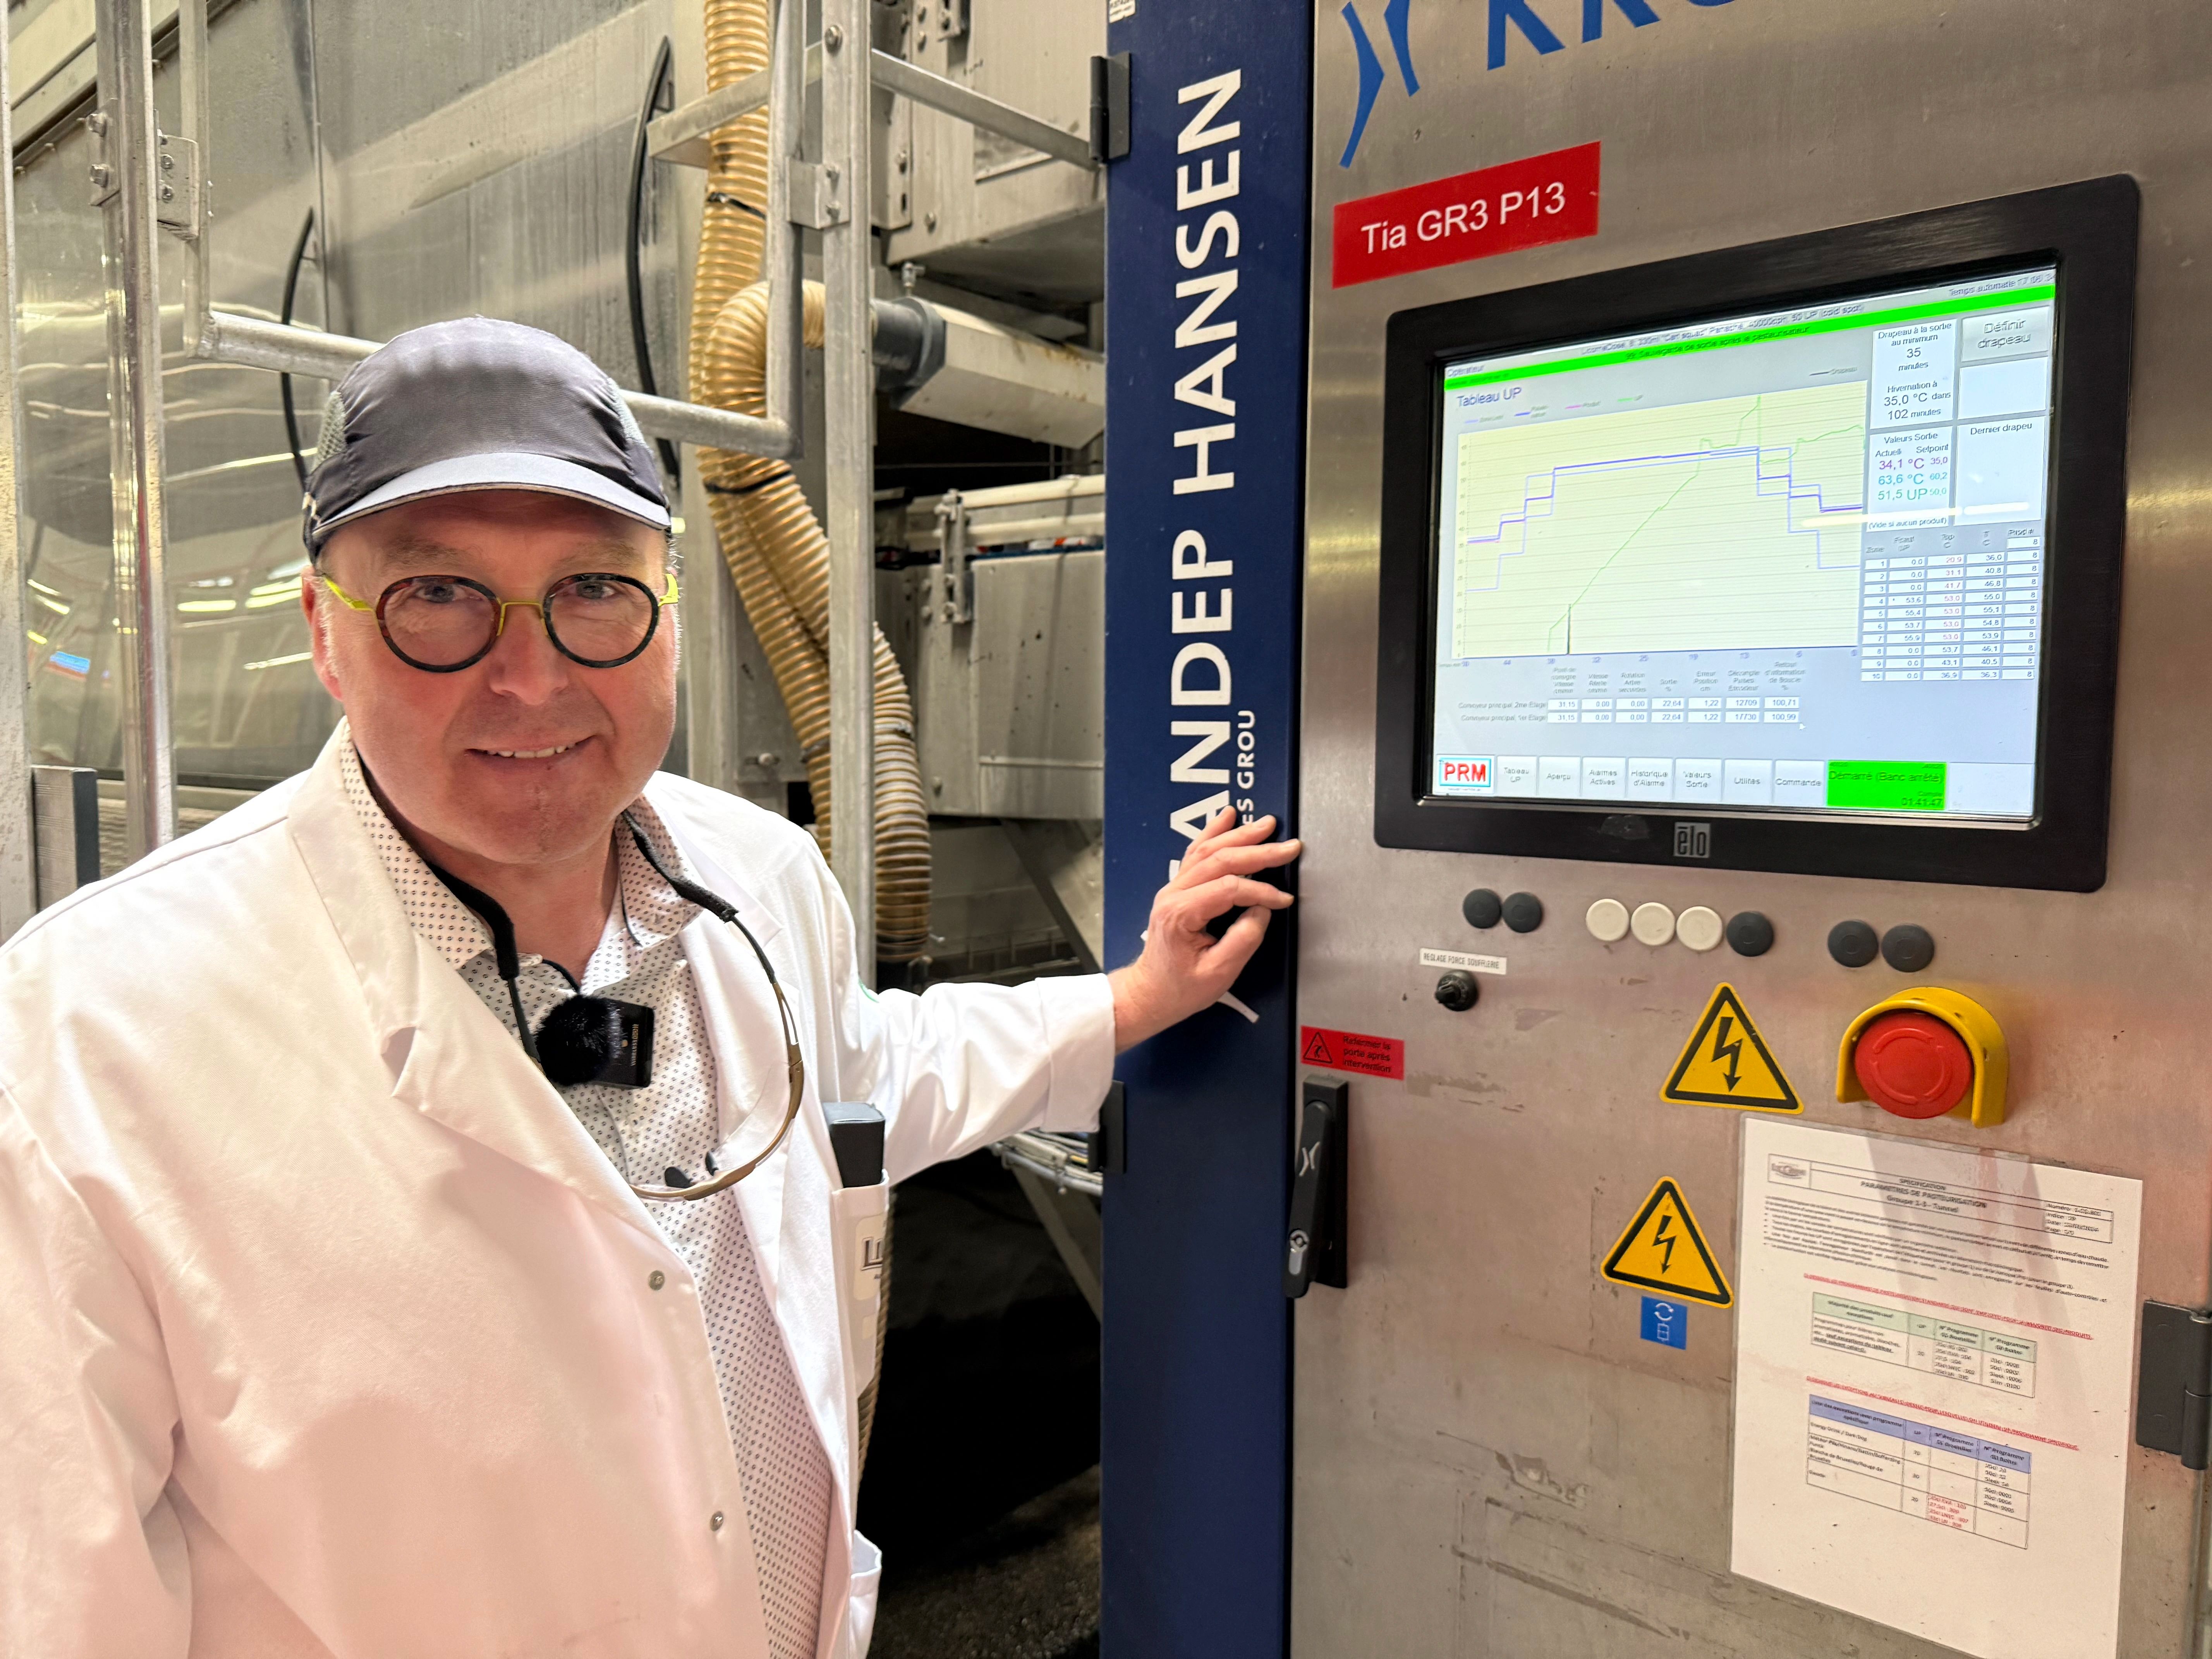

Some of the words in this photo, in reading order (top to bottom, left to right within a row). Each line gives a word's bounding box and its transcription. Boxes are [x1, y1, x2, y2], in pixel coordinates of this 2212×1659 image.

[1360, 221, 1407, 254] Tia
[1417, 199, 1489, 242] GR3
[1500, 182, 1566, 225] P13
[1173, 69, 1241, 495] HANSEN
[1984, 318, 2026, 333] Définir
[1878, 328, 1912, 340] Drapeau
[1914, 326, 1918, 335] à
[1903, 333, 1938, 345] minimum
[1978, 333, 2031, 349] drapeau
[1907, 348, 1921, 358] 35
[1898, 361, 1928, 372] minutes
[1887, 382, 1930, 393] Hivernation
[1457, 390, 1500, 407] Tableau
[1503, 387, 1522, 400] UP
[1884, 395, 1909, 407] 35,0
[1913, 393, 1927, 402] °C
[1932, 391, 1951, 400] dans
[1888, 410, 1908, 420] 102
[1911, 408, 1941, 417] minutes
[1971, 426, 2000, 435] Dernier
[2003, 422, 2032, 433] drapeu
[1884, 435, 1912, 444] Valeurs
[1915, 432, 1938, 441] Sortie
[1917, 444, 1949, 454] Setpoint
[1879, 460, 1902, 470] 34,1
[1908, 458, 1924, 469] °C
[1879, 475, 1903, 485] 63,6
[1908, 473, 1924, 484] °C
[1879, 490, 1902, 500] 51,5
[1907, 488, 1927, 500] UP
[1444, 763, 1486, 781] PRM
[1775, 778, 1822, 787] Commande
[1448, 956, 1465, 965] FORCE
[1344, 1049, 1365, 1058] porte
[1367, 1052, 1391, 1061] après
[1887, 1195, 1912, 1205] Groupe
